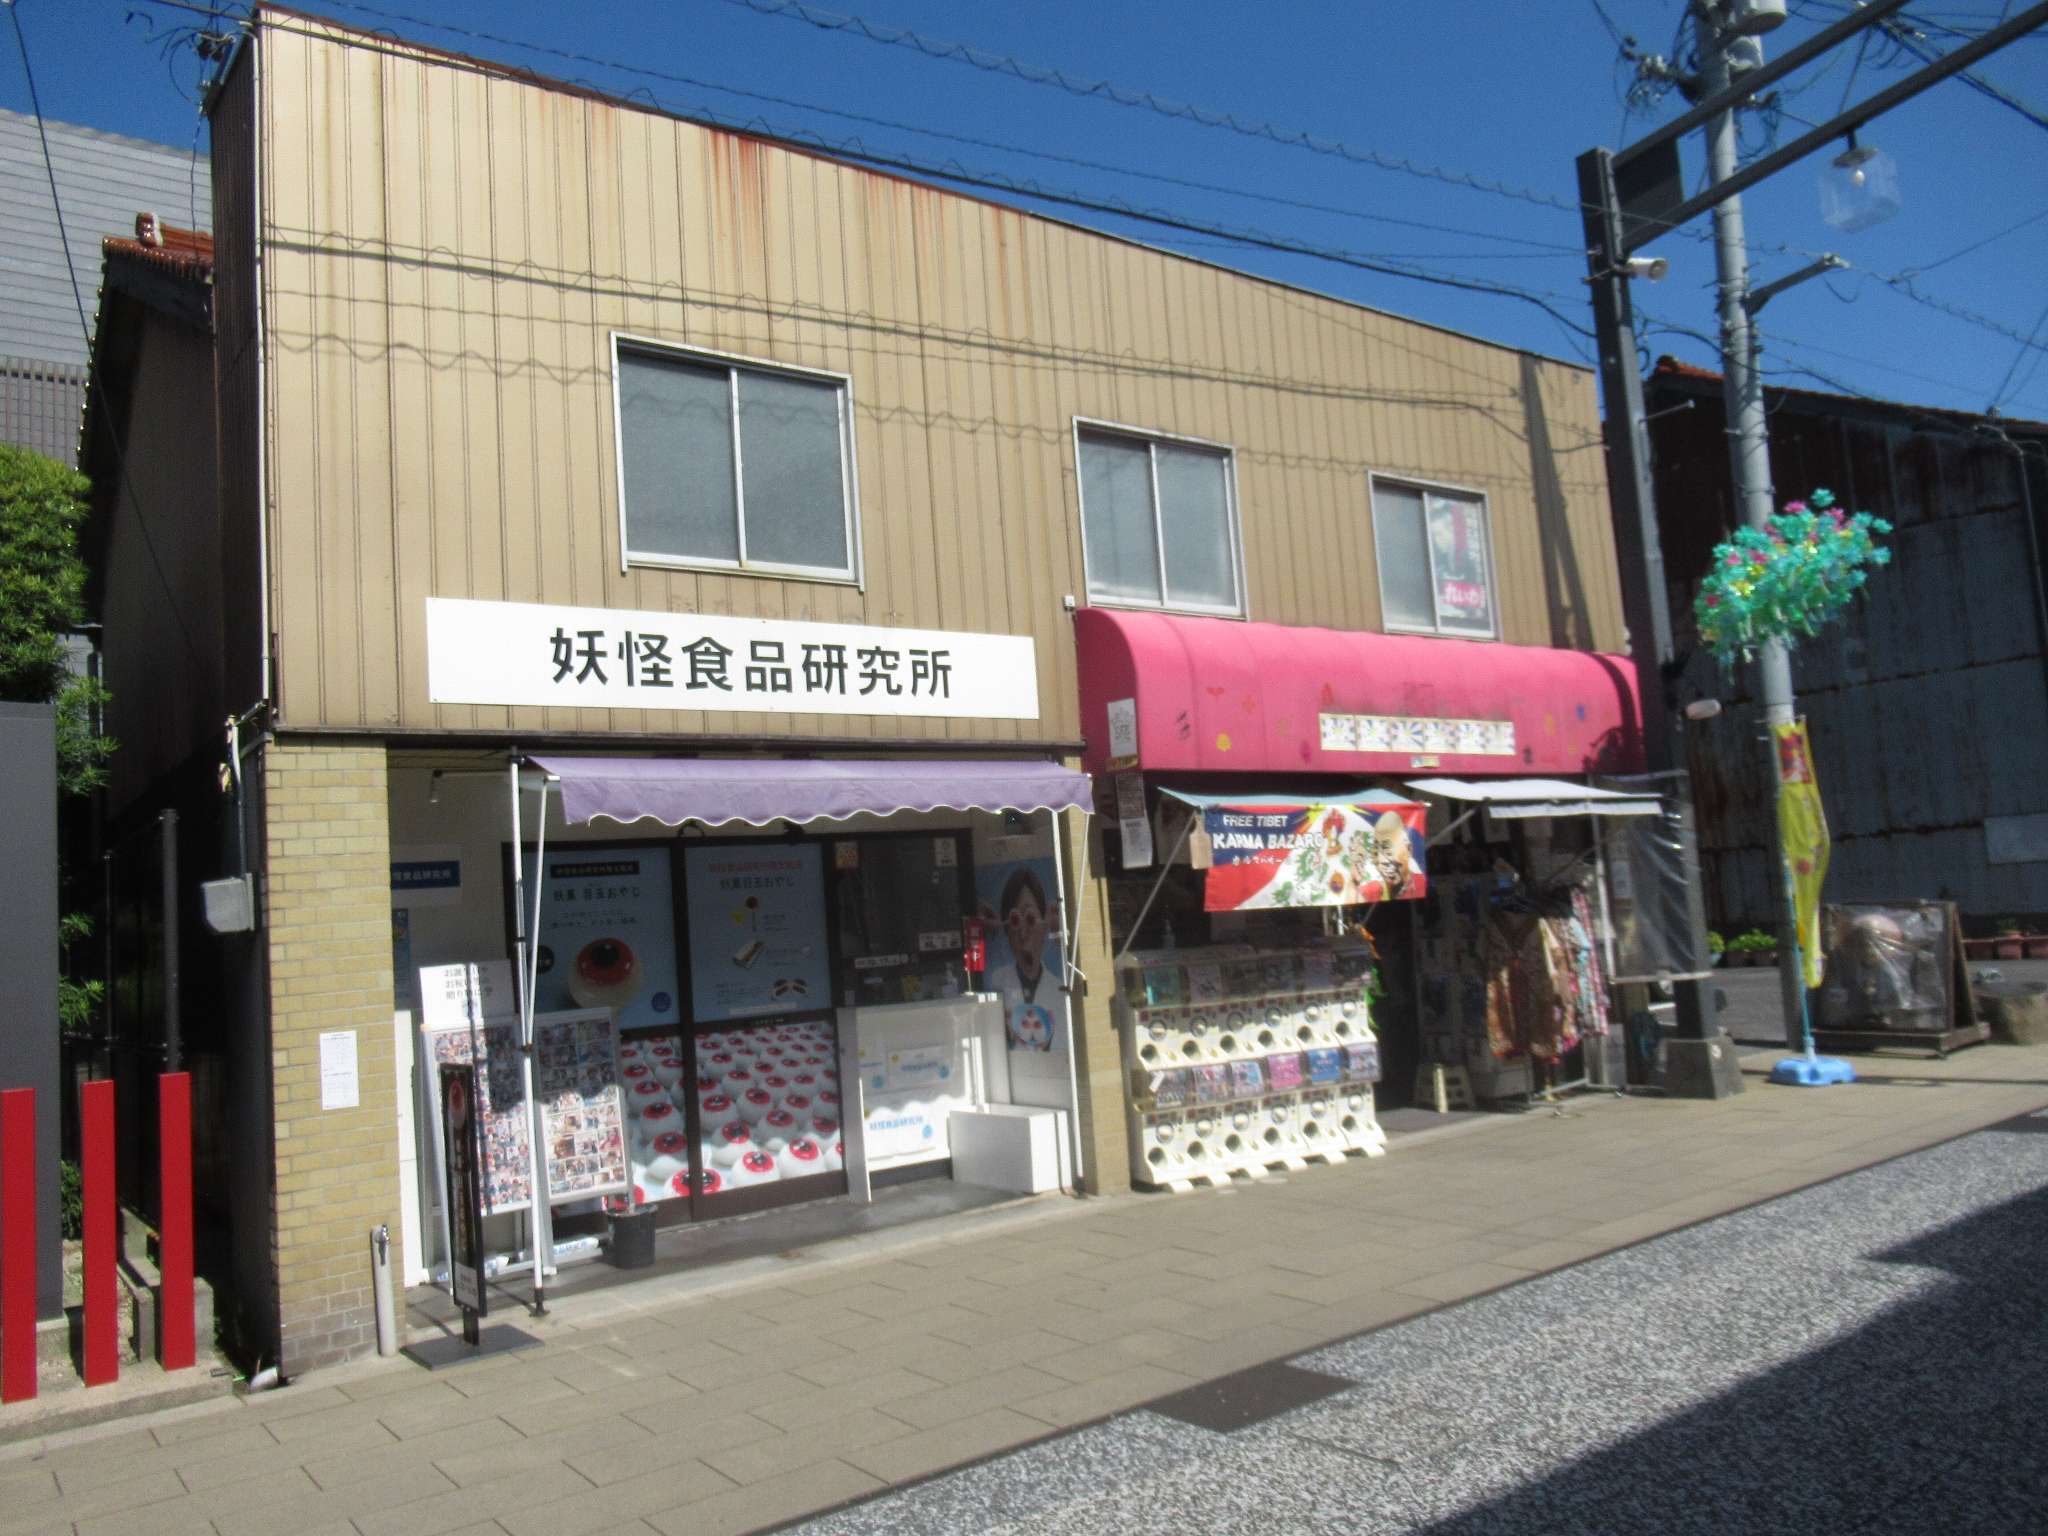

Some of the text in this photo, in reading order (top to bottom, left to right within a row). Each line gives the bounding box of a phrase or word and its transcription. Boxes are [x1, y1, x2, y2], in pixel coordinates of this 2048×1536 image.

[550, 627, 953, 698] 妖怪食品研究所
[1223, 815, 1288, 827] FREE TIBET
[1213, 833, 1264, 849] KARMA
